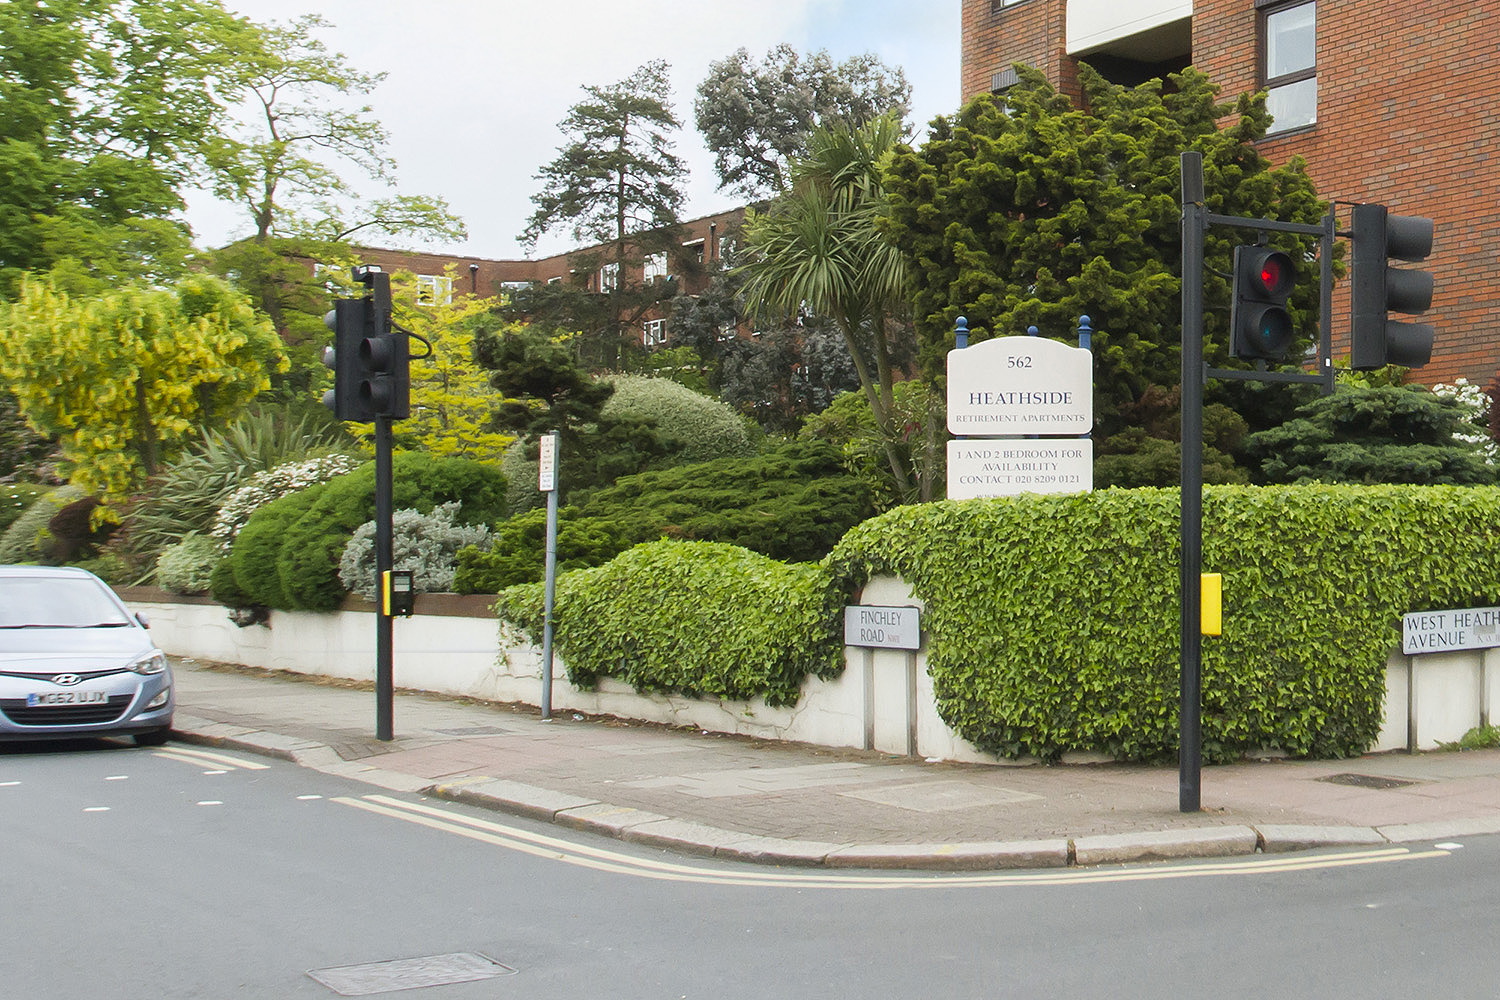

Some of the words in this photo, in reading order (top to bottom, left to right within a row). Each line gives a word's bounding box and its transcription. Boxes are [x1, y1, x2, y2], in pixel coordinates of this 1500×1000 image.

[1007, 356, 1032, 368] 562
[969, 391, 1073, 405] HEATHSIDE
[956, 414, 1018, 423] RETIREMENT
[1021, 414, 1085, 423] APARTMENTS
[957, 451, 962, 459] 1
[965, 450, 992, 459] AND
[995, 450, 1001, 459] 2
[1003, 449, 1058, 459] BEDROOM
[1061, 449, 1083, 458] FOR
[982, 462, 1058, 471] AVAILABILITY
[959, 475, 1012, 485] CONTACT
[1015, 475, 1032, 484] 020
[1034, 475, 1056, 484] 8209
[1058, 474, 1080, 483] 0121
[860, 611, 902, 626] FINCHLEY
[1407, 615, 1447, 631] WEST
[1454, 611, 1500, 627] HEATH
[860, 629, 885, 642] ROAD
[1408, 631, 1466, 649] AVENUE
